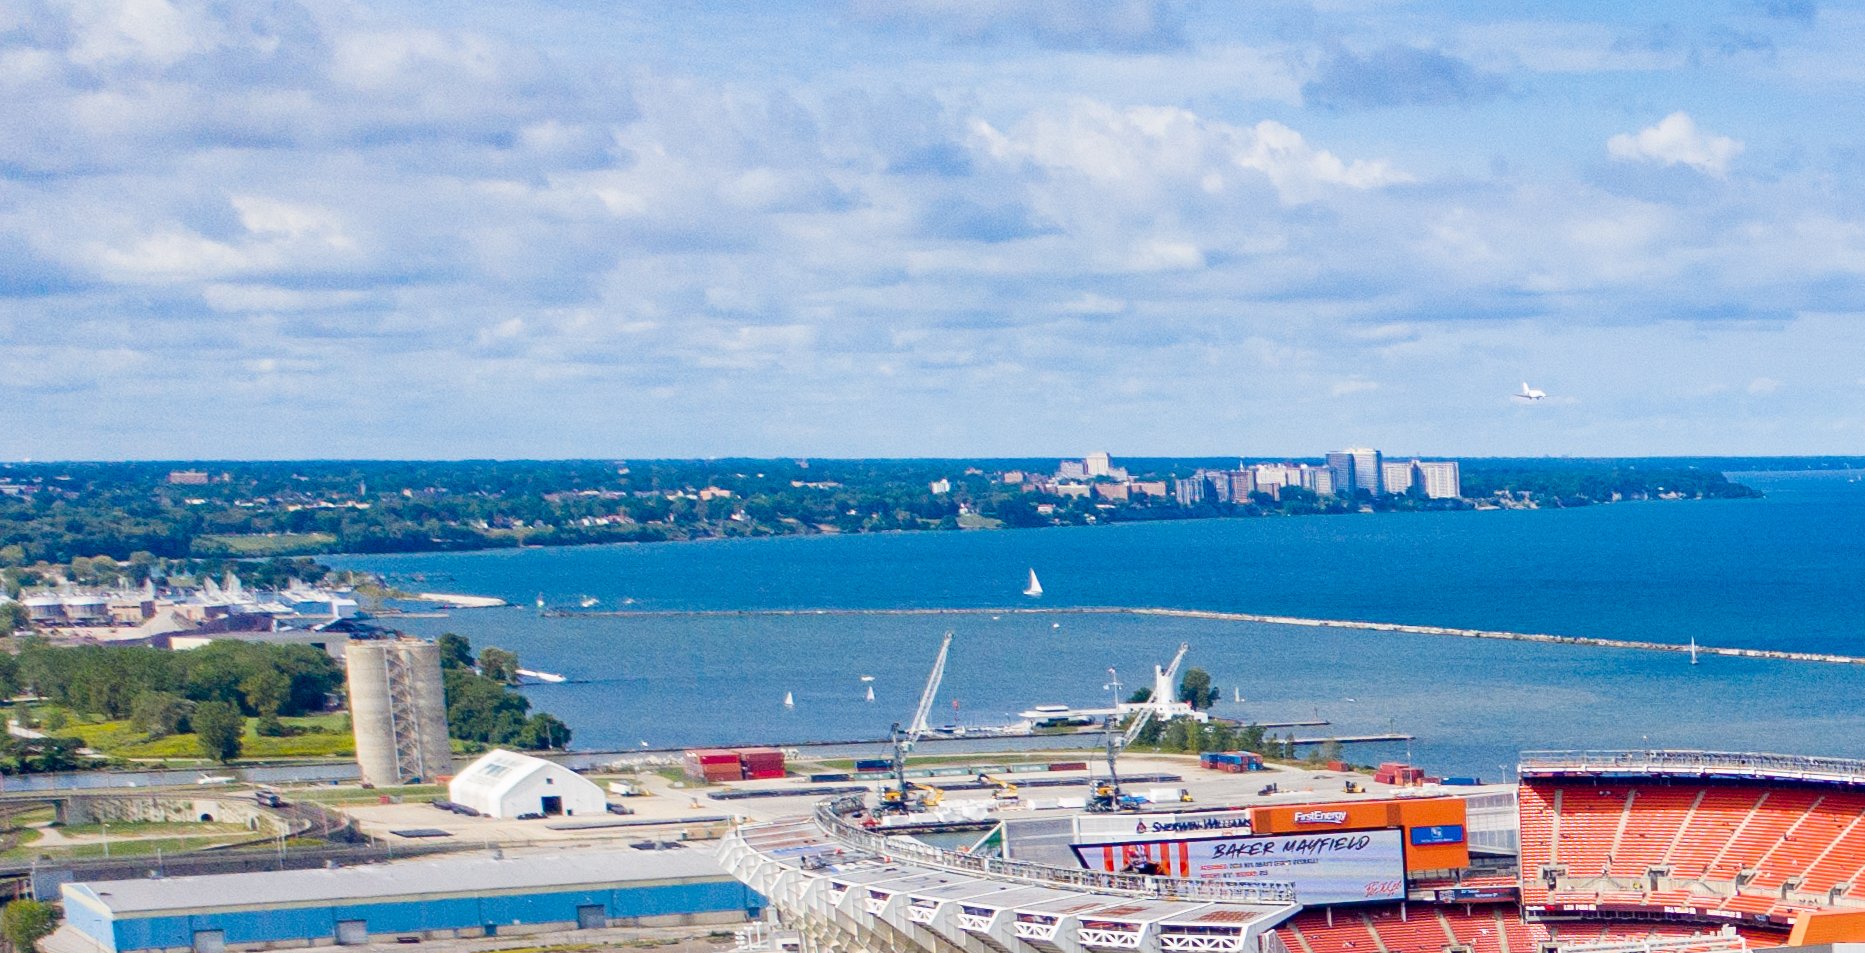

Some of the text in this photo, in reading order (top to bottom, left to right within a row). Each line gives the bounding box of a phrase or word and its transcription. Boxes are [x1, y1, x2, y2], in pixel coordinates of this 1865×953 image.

[1294, 811, 1347, 822] FirstEnergy
[1212, 835, 1370, 859] BAKER MAYFIELD
